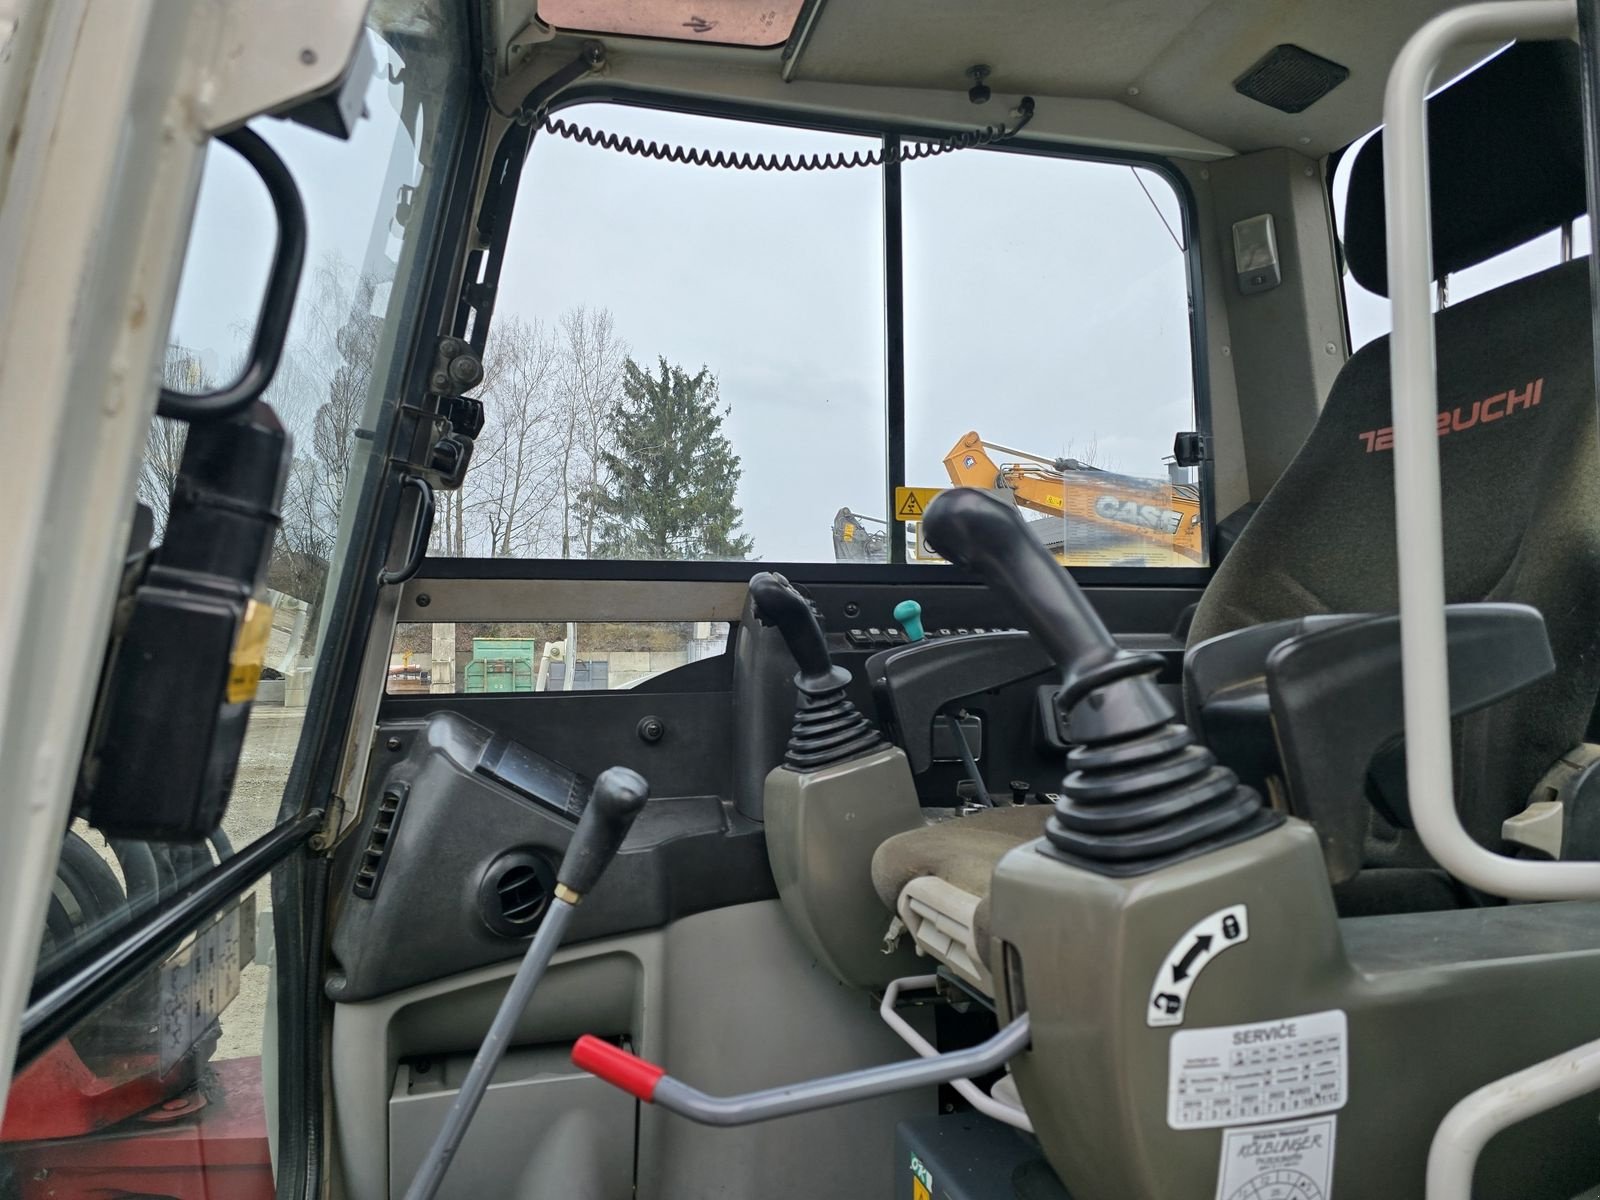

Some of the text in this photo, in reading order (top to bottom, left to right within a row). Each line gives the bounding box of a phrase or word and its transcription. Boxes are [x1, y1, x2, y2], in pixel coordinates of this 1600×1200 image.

[1359, 378, 1544, 453] TAEUCHI
[1096, 495, 1184, 535] CASE
[1232, 1023, 1297, 1045] SERVICE
